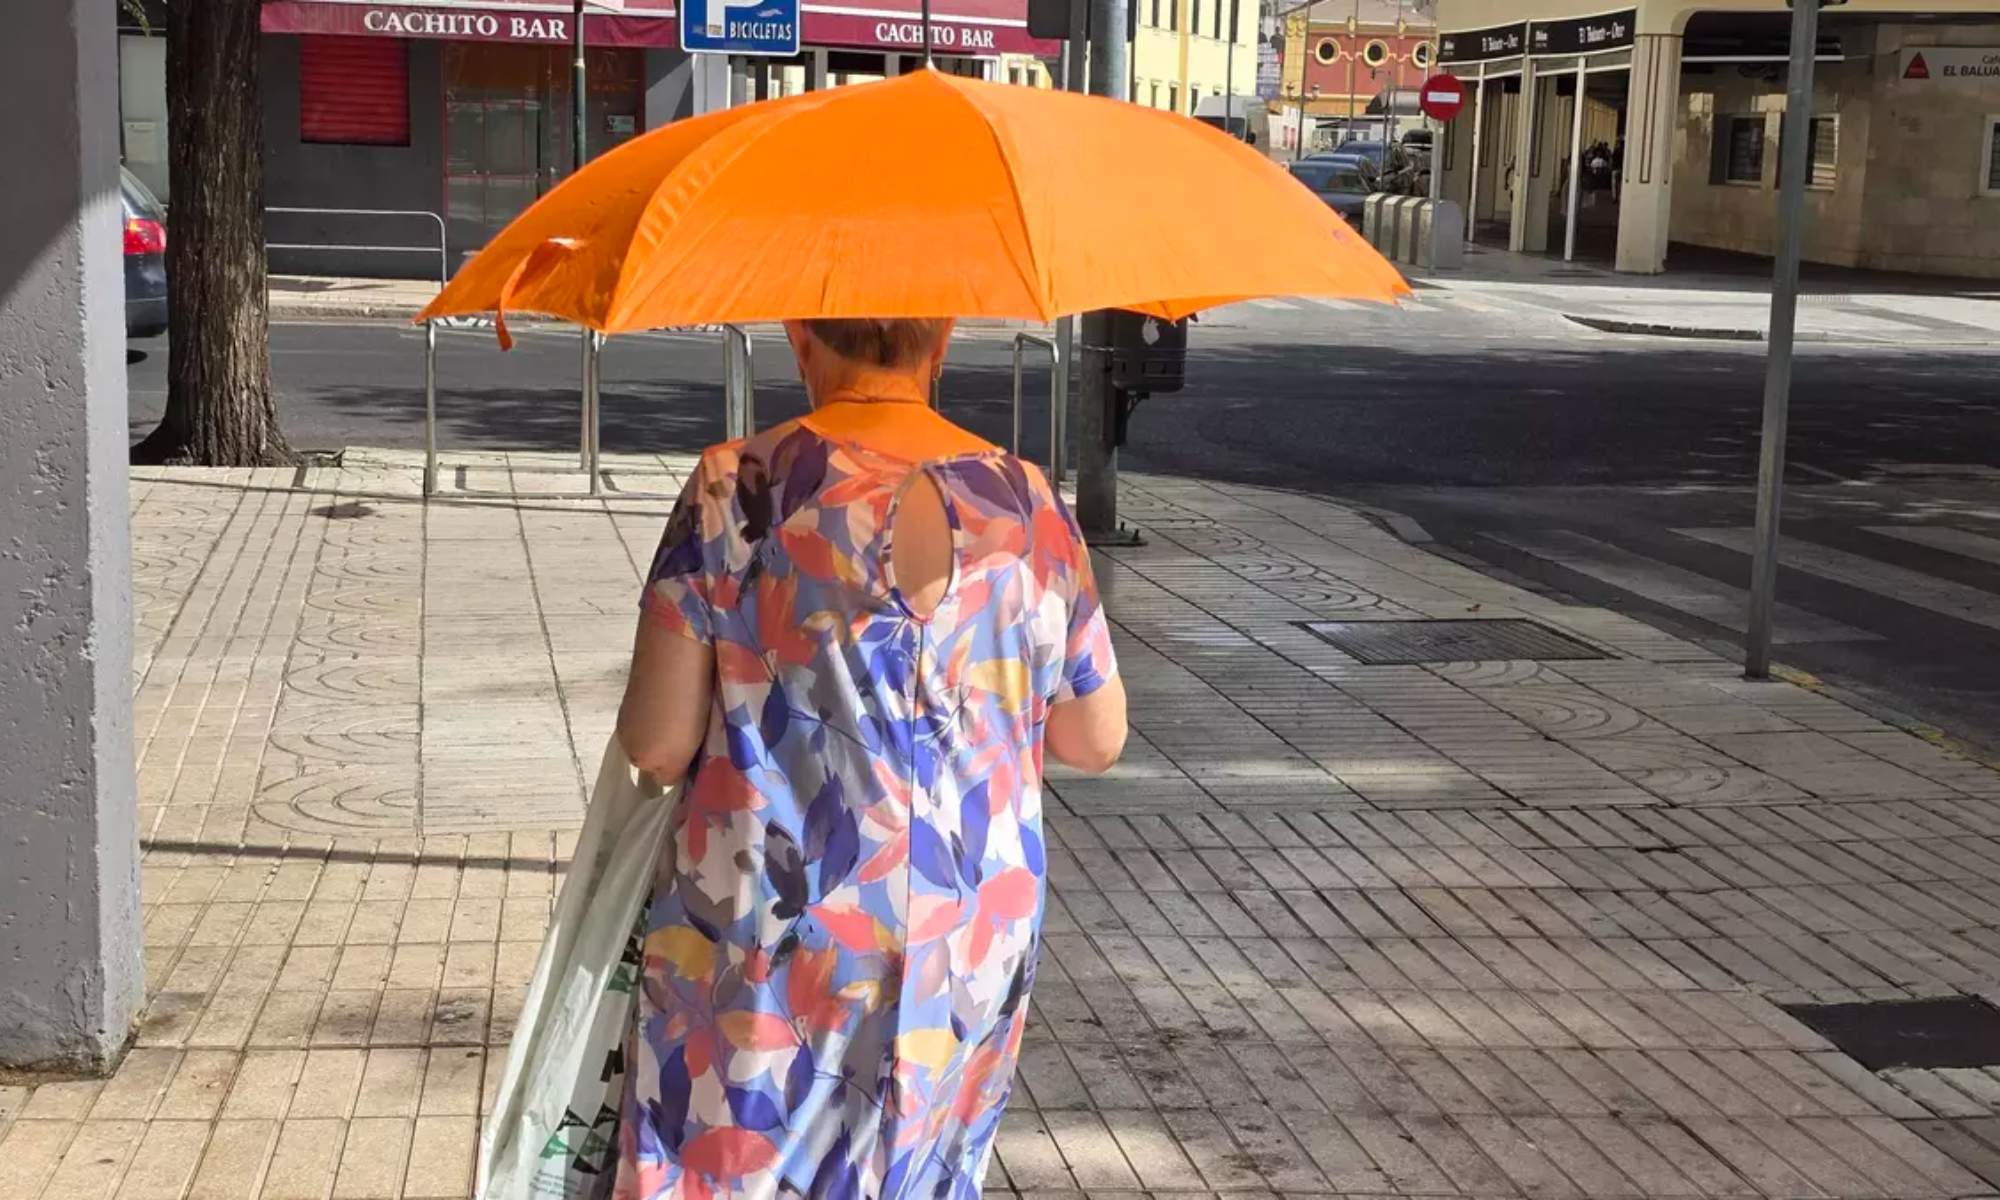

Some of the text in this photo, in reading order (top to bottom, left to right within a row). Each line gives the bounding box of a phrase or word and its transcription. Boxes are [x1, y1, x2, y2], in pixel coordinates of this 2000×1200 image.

[364, 10, 568, 40] CACHITO BAR
[729, 21, 792, 40] BICICLETAS
[875, 23, 996, 48] CACHTO BAR
[1943, 65, 1957, 77] EL
